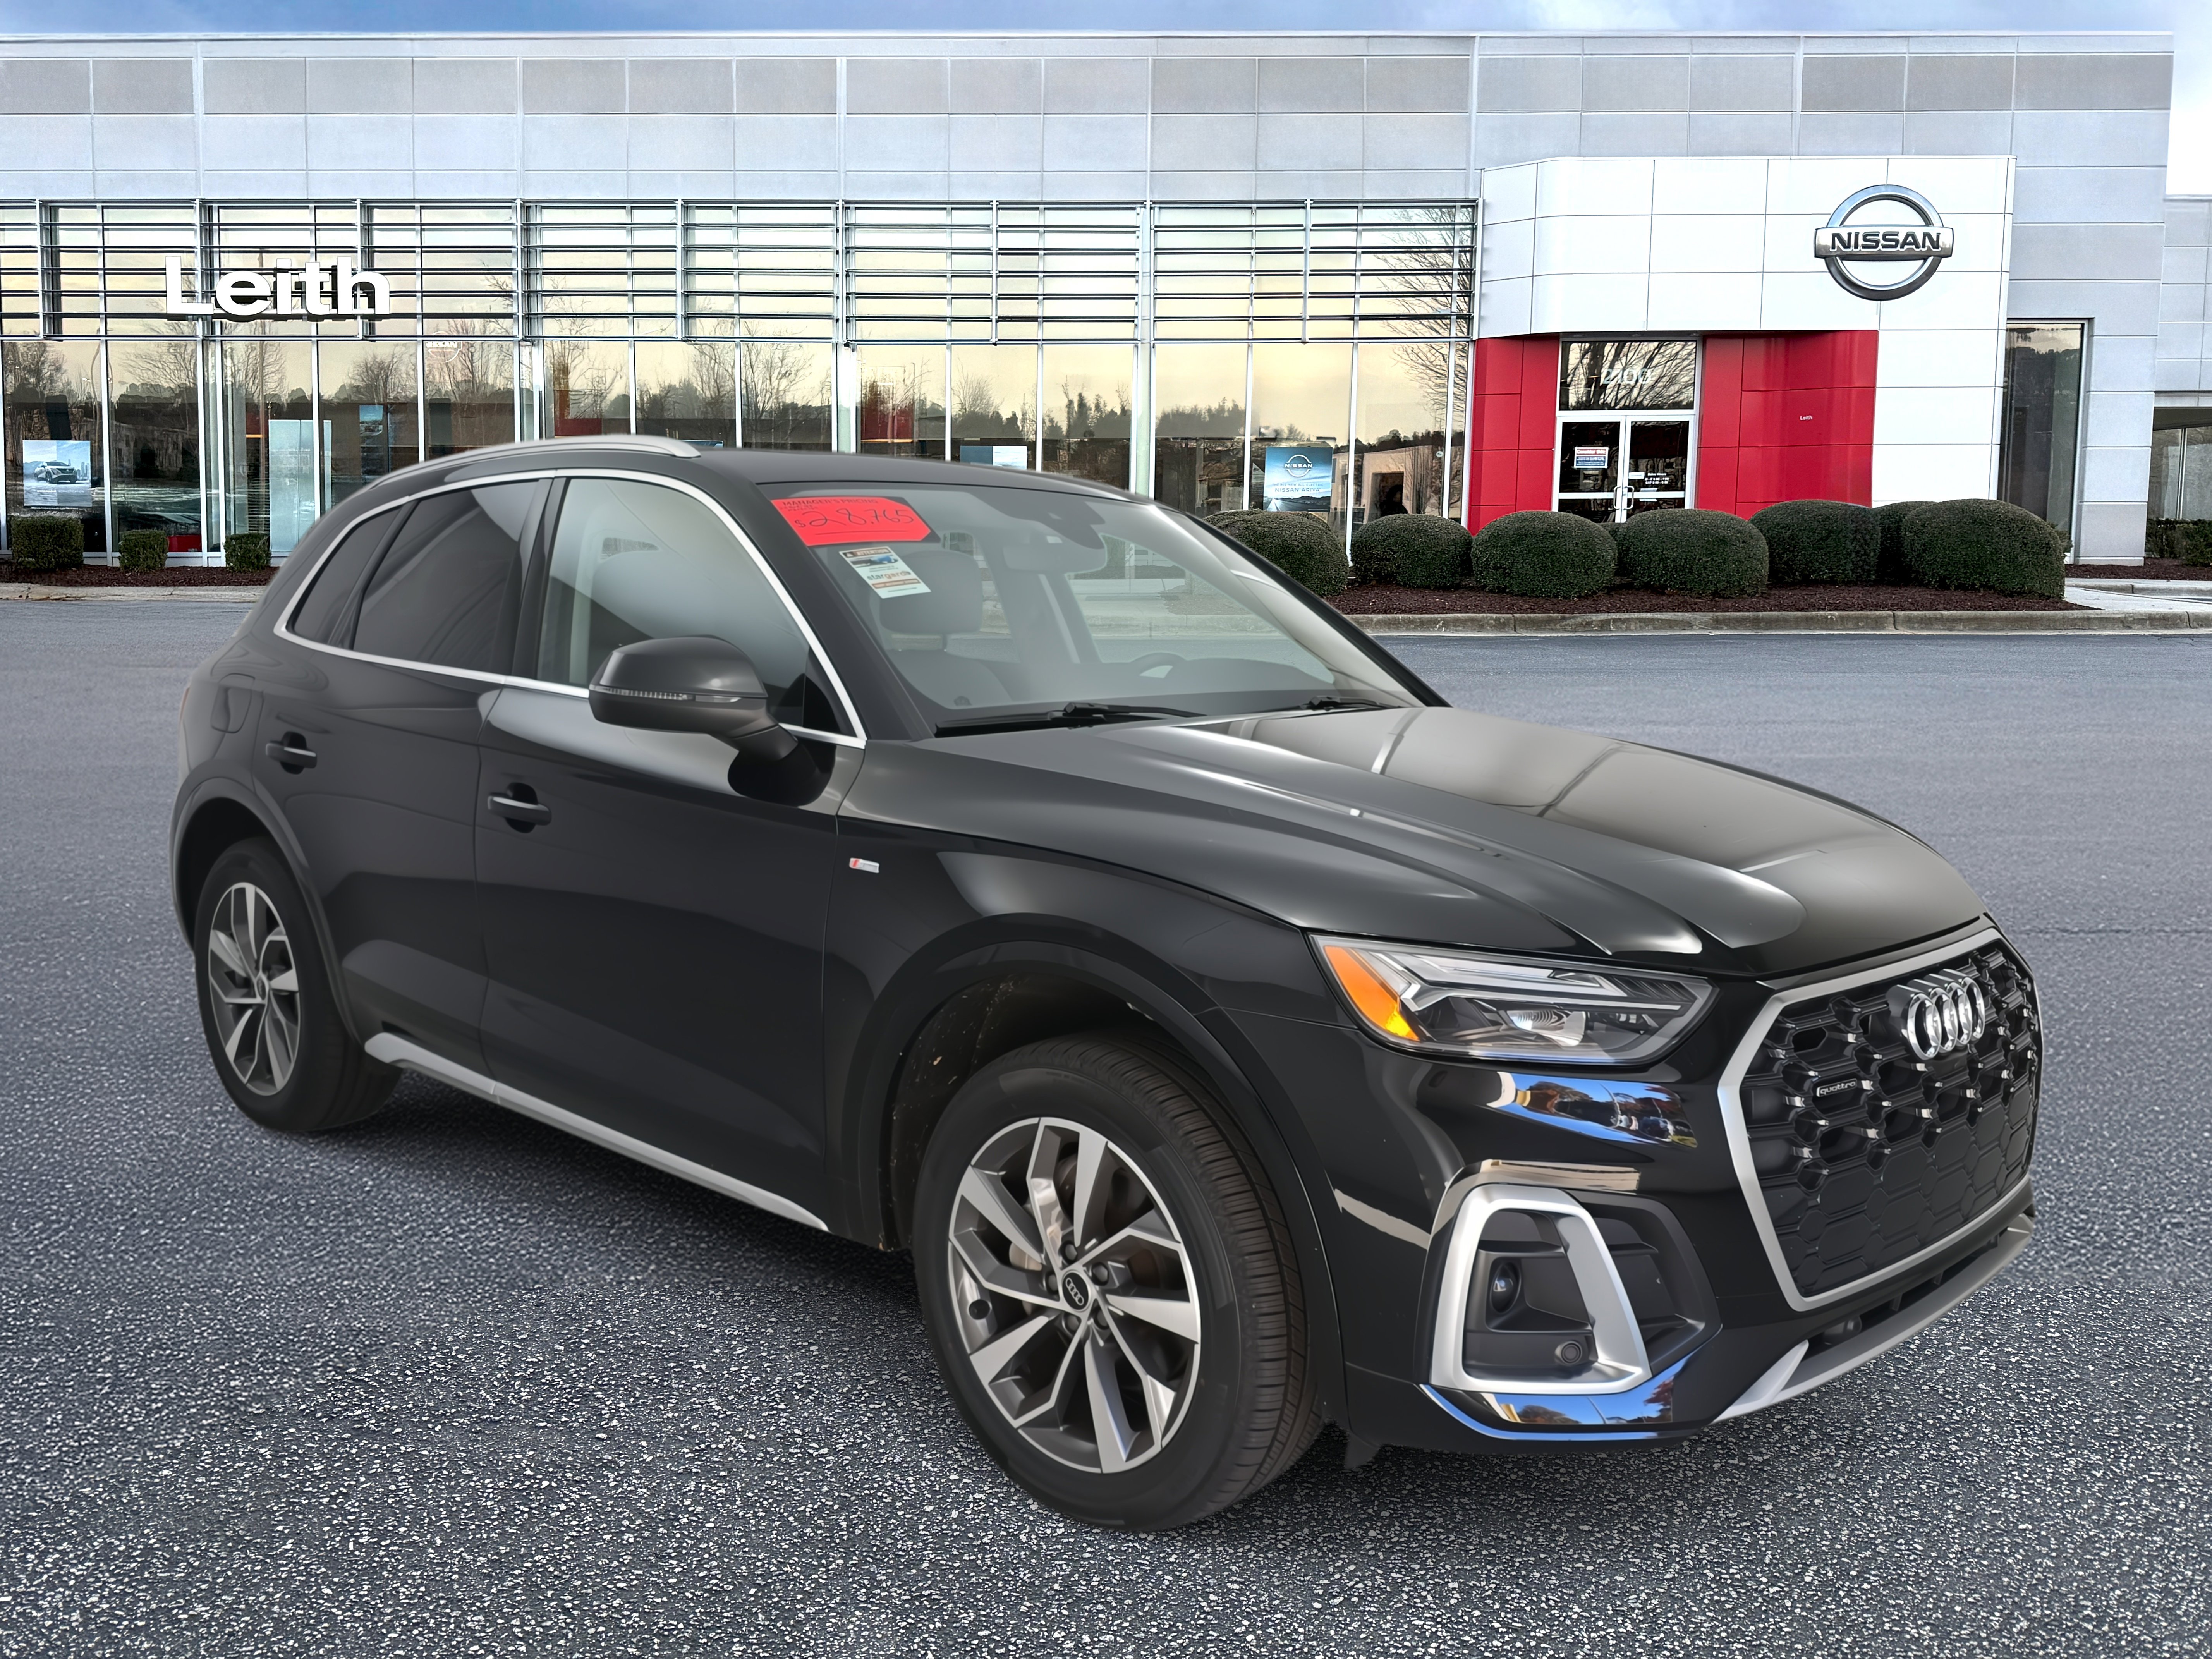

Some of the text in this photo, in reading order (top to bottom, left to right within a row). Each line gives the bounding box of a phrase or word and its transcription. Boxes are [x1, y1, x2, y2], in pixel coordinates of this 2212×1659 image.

[1830, 231, 1941, 251] NISSAN
[166, 256, 390, 315] Leith
[1820, 1081, 1856, 1095] quattro
